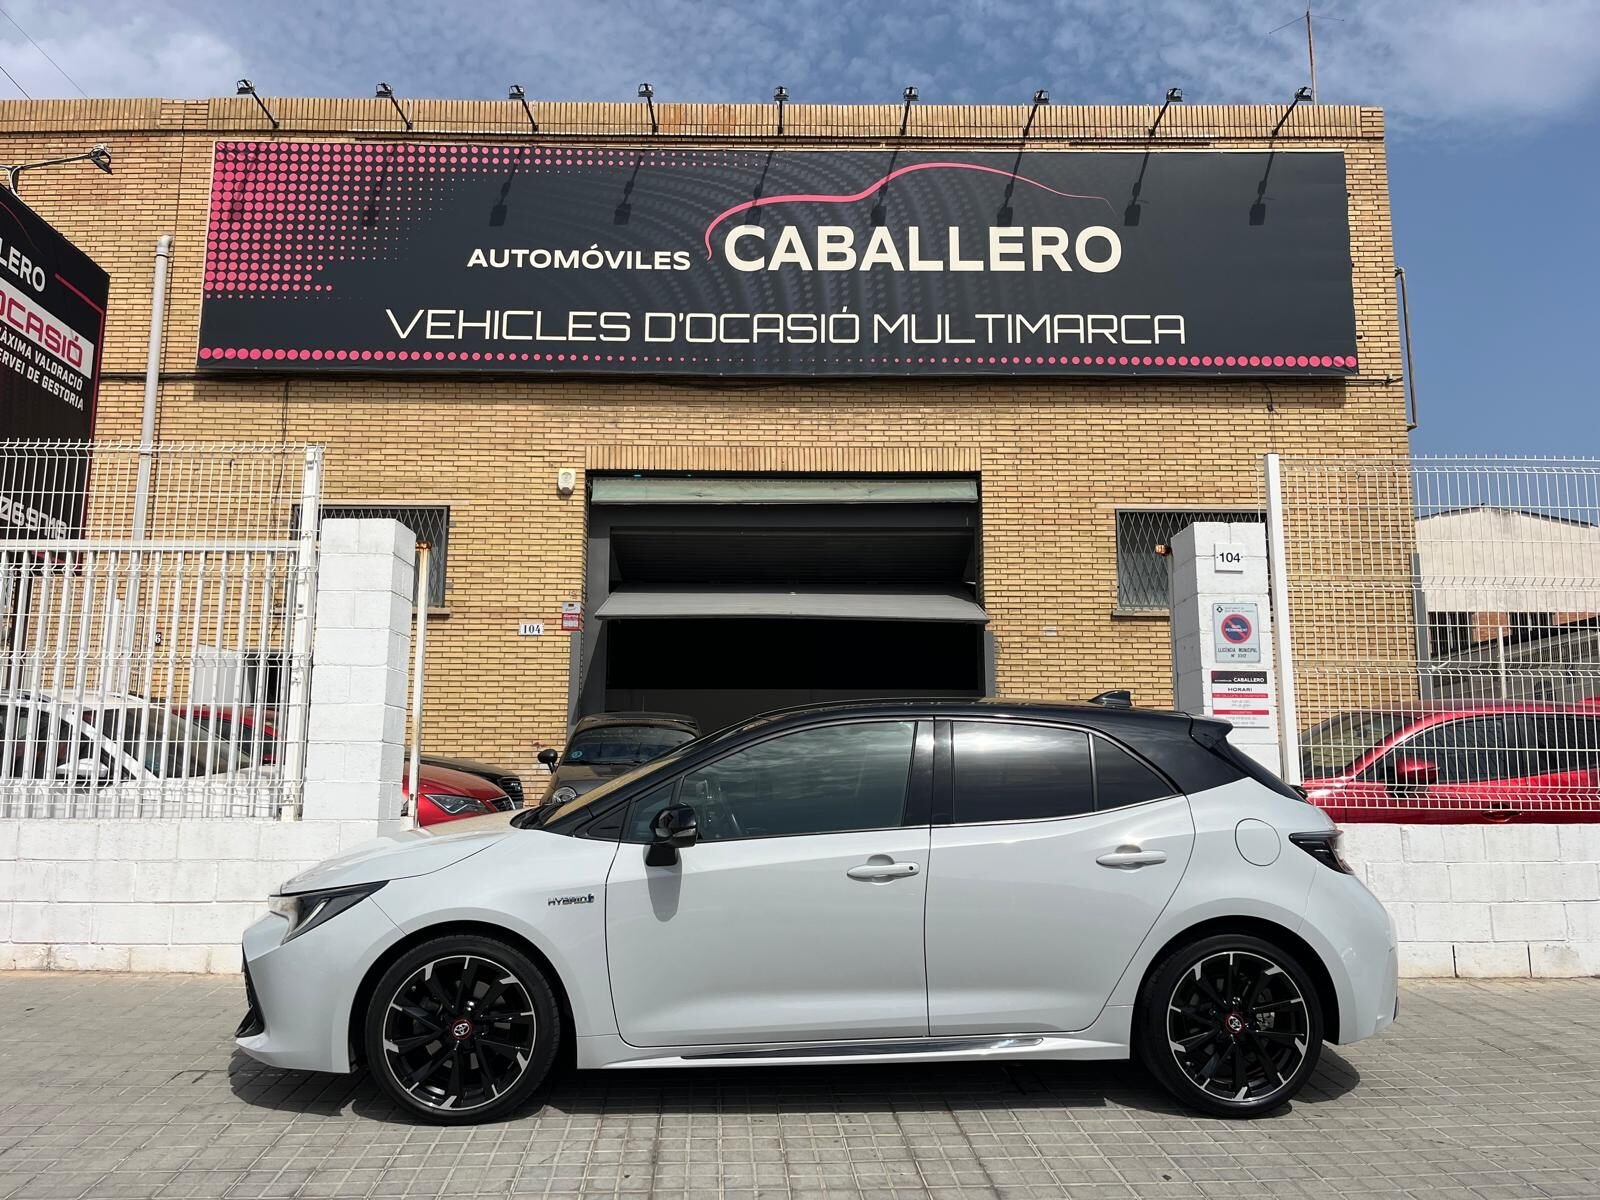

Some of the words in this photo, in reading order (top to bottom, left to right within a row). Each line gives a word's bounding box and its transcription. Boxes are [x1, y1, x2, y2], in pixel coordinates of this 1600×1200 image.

[466, 243, 691, 271] AUTOMÓVILES
[724, 224, 1122, 273] CABALLERO
[385, 308, 631, 343] VEHICLES
[873, 313, 1186, 345] MULTIMARCA
[27, 366, 40, 384] DE
[42, 375, 84, 411] GESTORIA
[35, 350, 83, 391] VALORACIÓ
[1219, 552, 1241, 563] 104
[523, 624, 541, 634] 104
